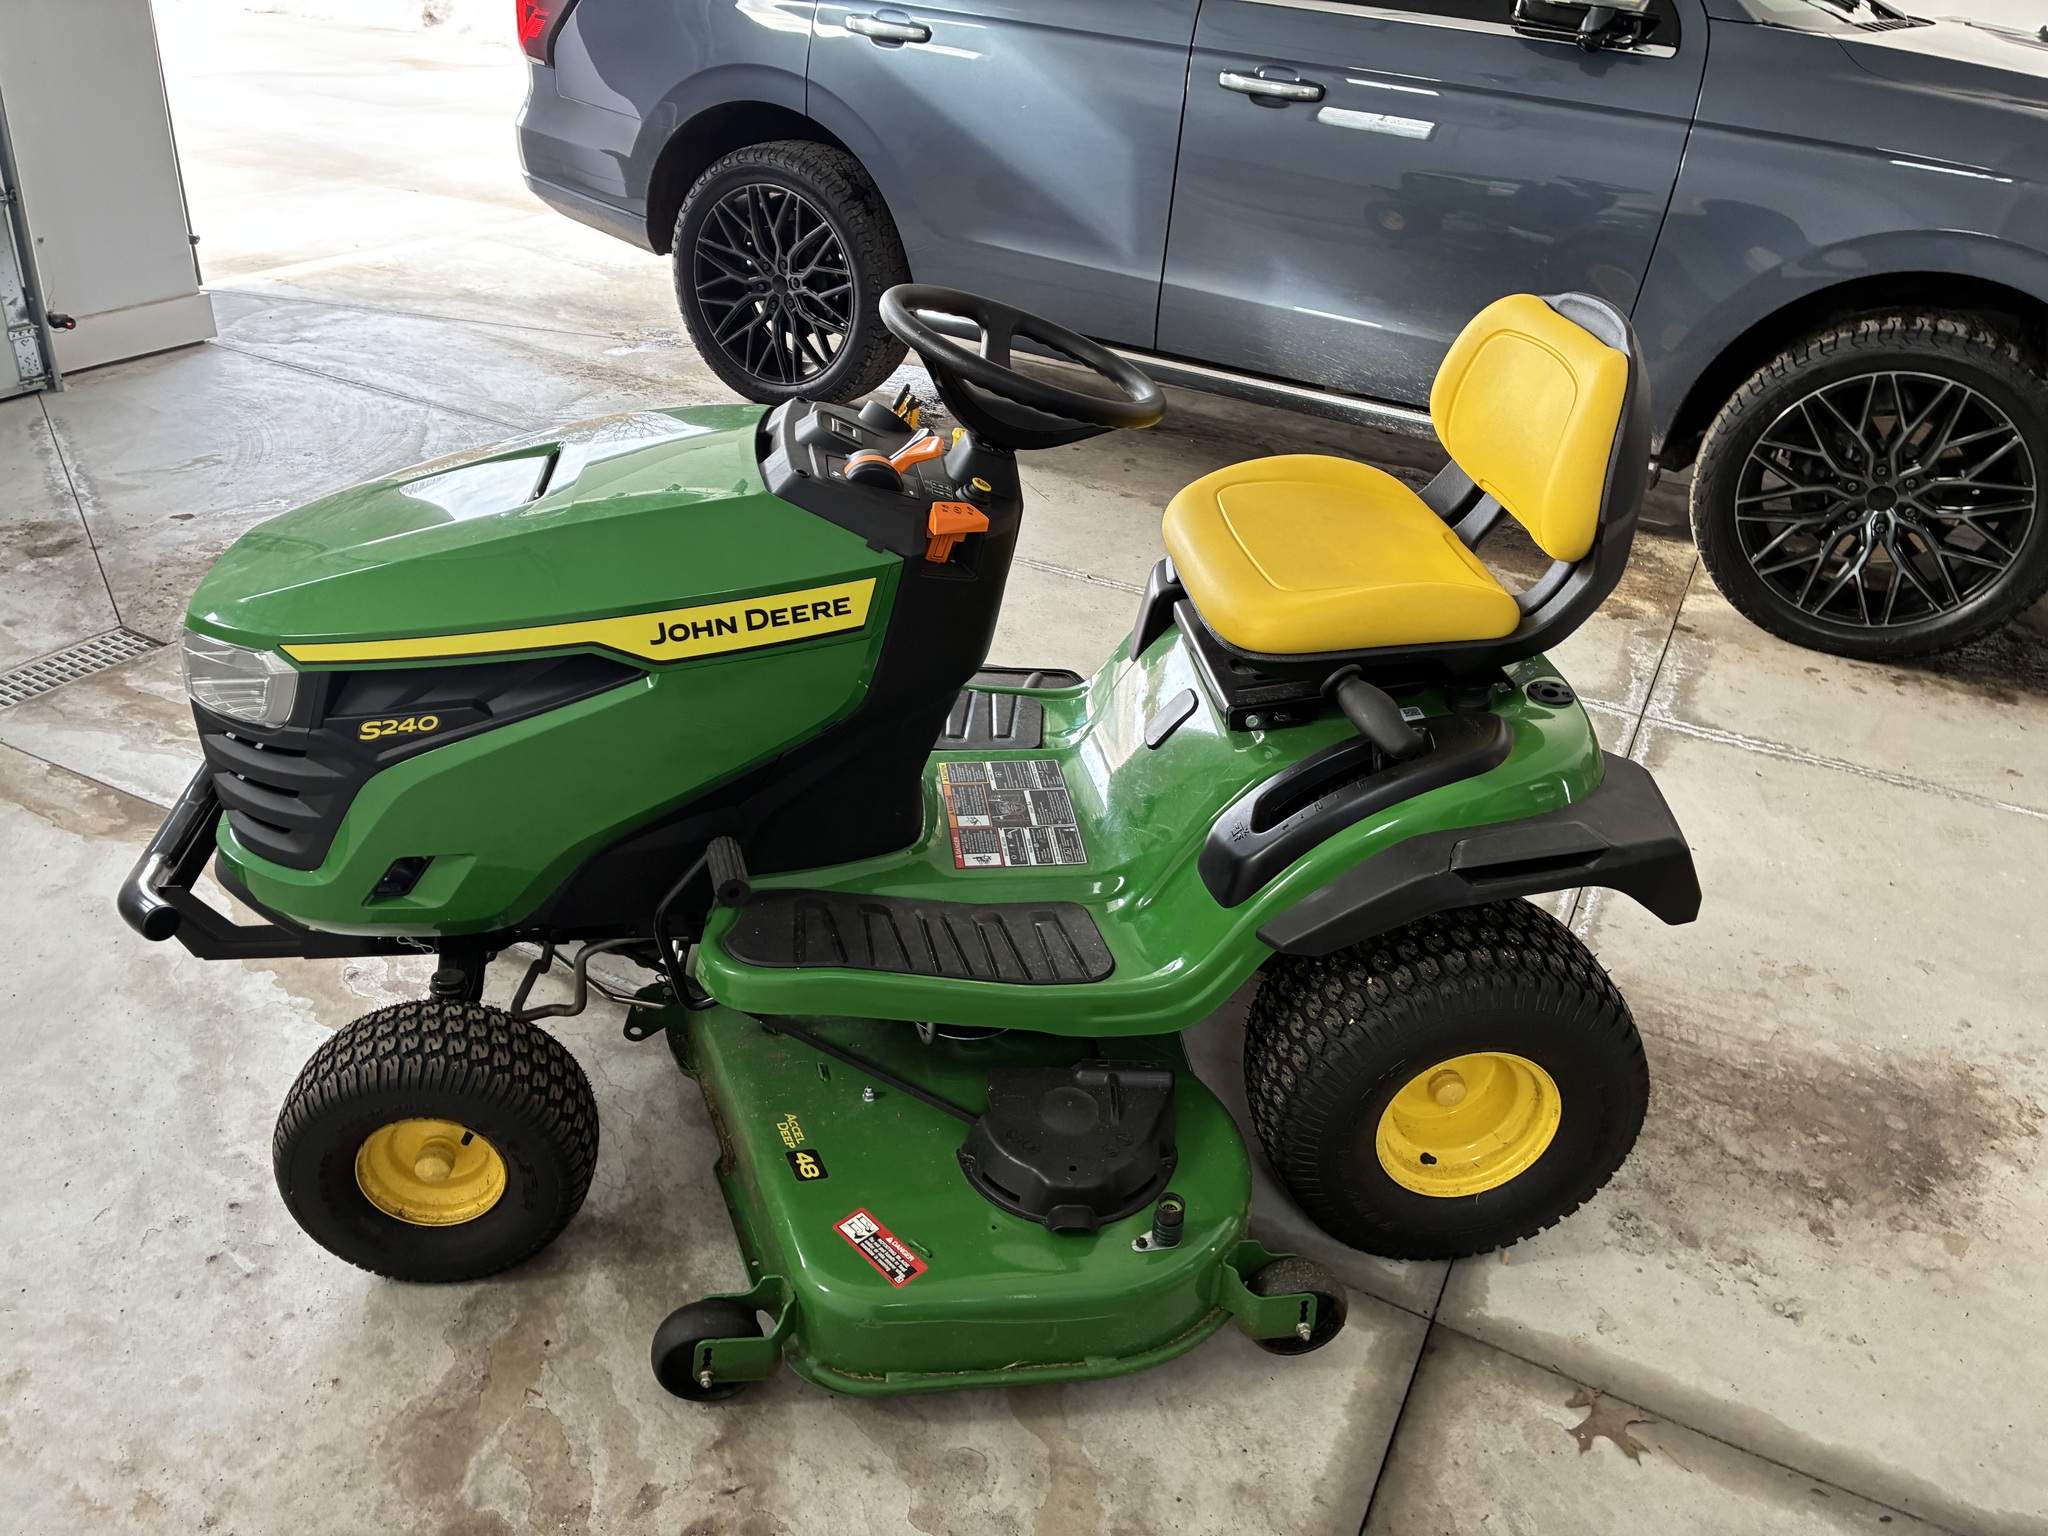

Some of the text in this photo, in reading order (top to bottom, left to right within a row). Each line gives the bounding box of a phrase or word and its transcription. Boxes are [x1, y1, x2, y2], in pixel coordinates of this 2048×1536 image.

[650, 597, 852, 646] JOHN DEERE
[359, 715, 439, 740] S240
[953, 837, 962, 854] DANGER
[776, 1122, 796, 1149] DEEP
[784, 1113, 806, 1145] ACCEL
[795, 1152, 820, 1179] 48
[891, 1240, 915, 1262] DANGER
